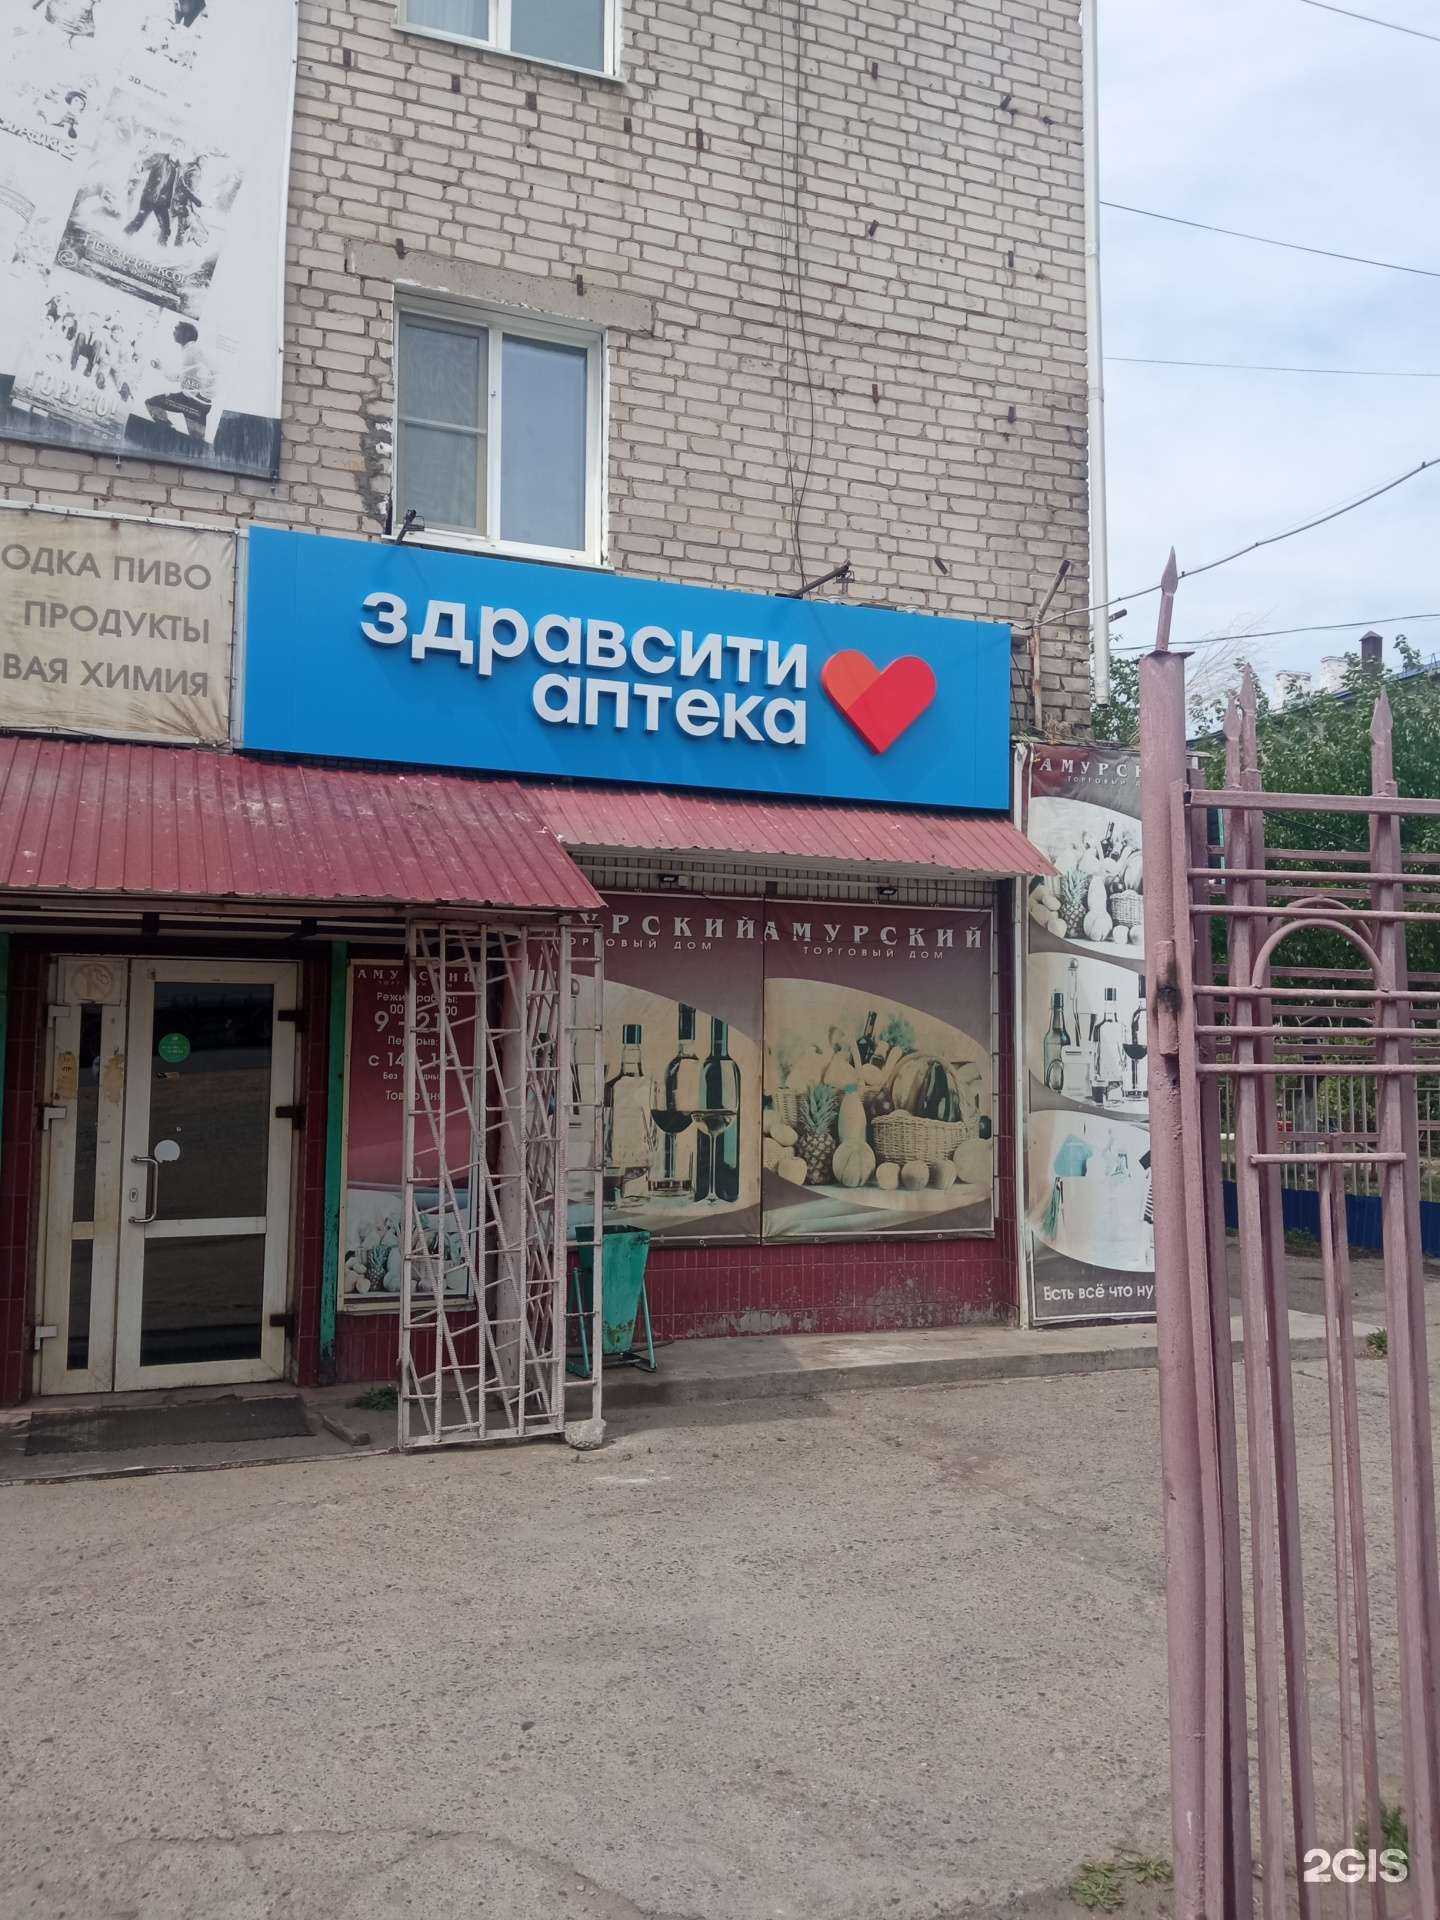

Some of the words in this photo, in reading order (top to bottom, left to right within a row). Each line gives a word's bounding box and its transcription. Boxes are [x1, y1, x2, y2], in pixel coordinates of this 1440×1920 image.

[1, 543, 101, 579] ОДКА
[113, 555, 211, 590] ПИВО
[24, 600, 209, 644] ПРОДУКТЫ
[360, 591, 808, 690] здравсити
[2, 652, 68, 684] ВАЯ
[80, 660, 208, 698] ХИМИЯ
[532, 673, 807, 745] аптека
[674, 941, 712, 951] ДОМ
[764, 918, 983, 949] АМУРСКИЙ
[803, 945, 896, 959] ТОРГОВЫЙ
[909, 949, 944, 960] ДОМ
[1043, 1286, 1074, 1301] Есть
[1078, 1283, 1105, 1299] всё
[1109, 1285, 1133, 1298] что
[1137, 1285, 1156, 1299] ну
